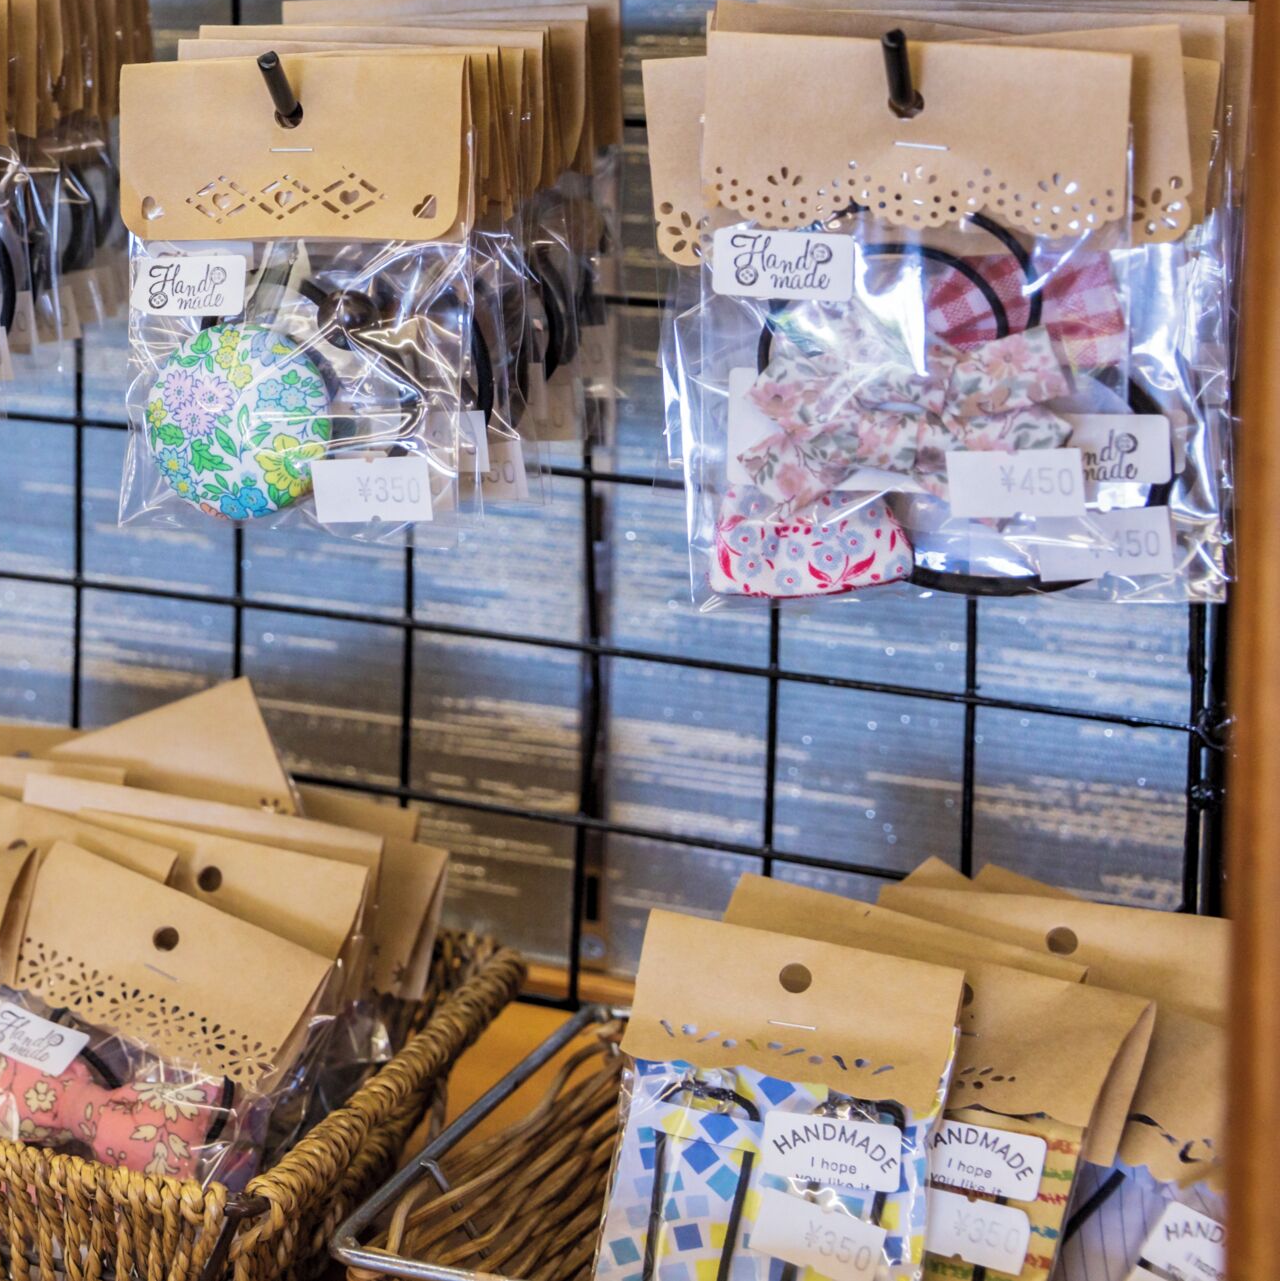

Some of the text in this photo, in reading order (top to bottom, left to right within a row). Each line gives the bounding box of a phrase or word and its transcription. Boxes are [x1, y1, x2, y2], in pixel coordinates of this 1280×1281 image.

[731, 234, 811, 272] Hand
[148, 263, 213, 297] Hand
[770, 266, 831, 290] made
[177, 289, 224, 310] made
[1083, 429, 1116, 466] nd
[358, 476, 421, 504] ¥350
[1000, 465, 1075, 496] ¥450
[0, 1010, 53, 1048] Hand
[772, 1123, 898, 1173] HANDMADE
[928, 1128, 1034, 1181] ANDMADE
[821, 1157, 857, 1175] hope
[958, 1159, 993, 1179] hope
[804, 1219, 872, 1272] ¥350
[952, 1208, 1020, 1251] ¥350
[1164, 1220, 1226, 1244] HAND
